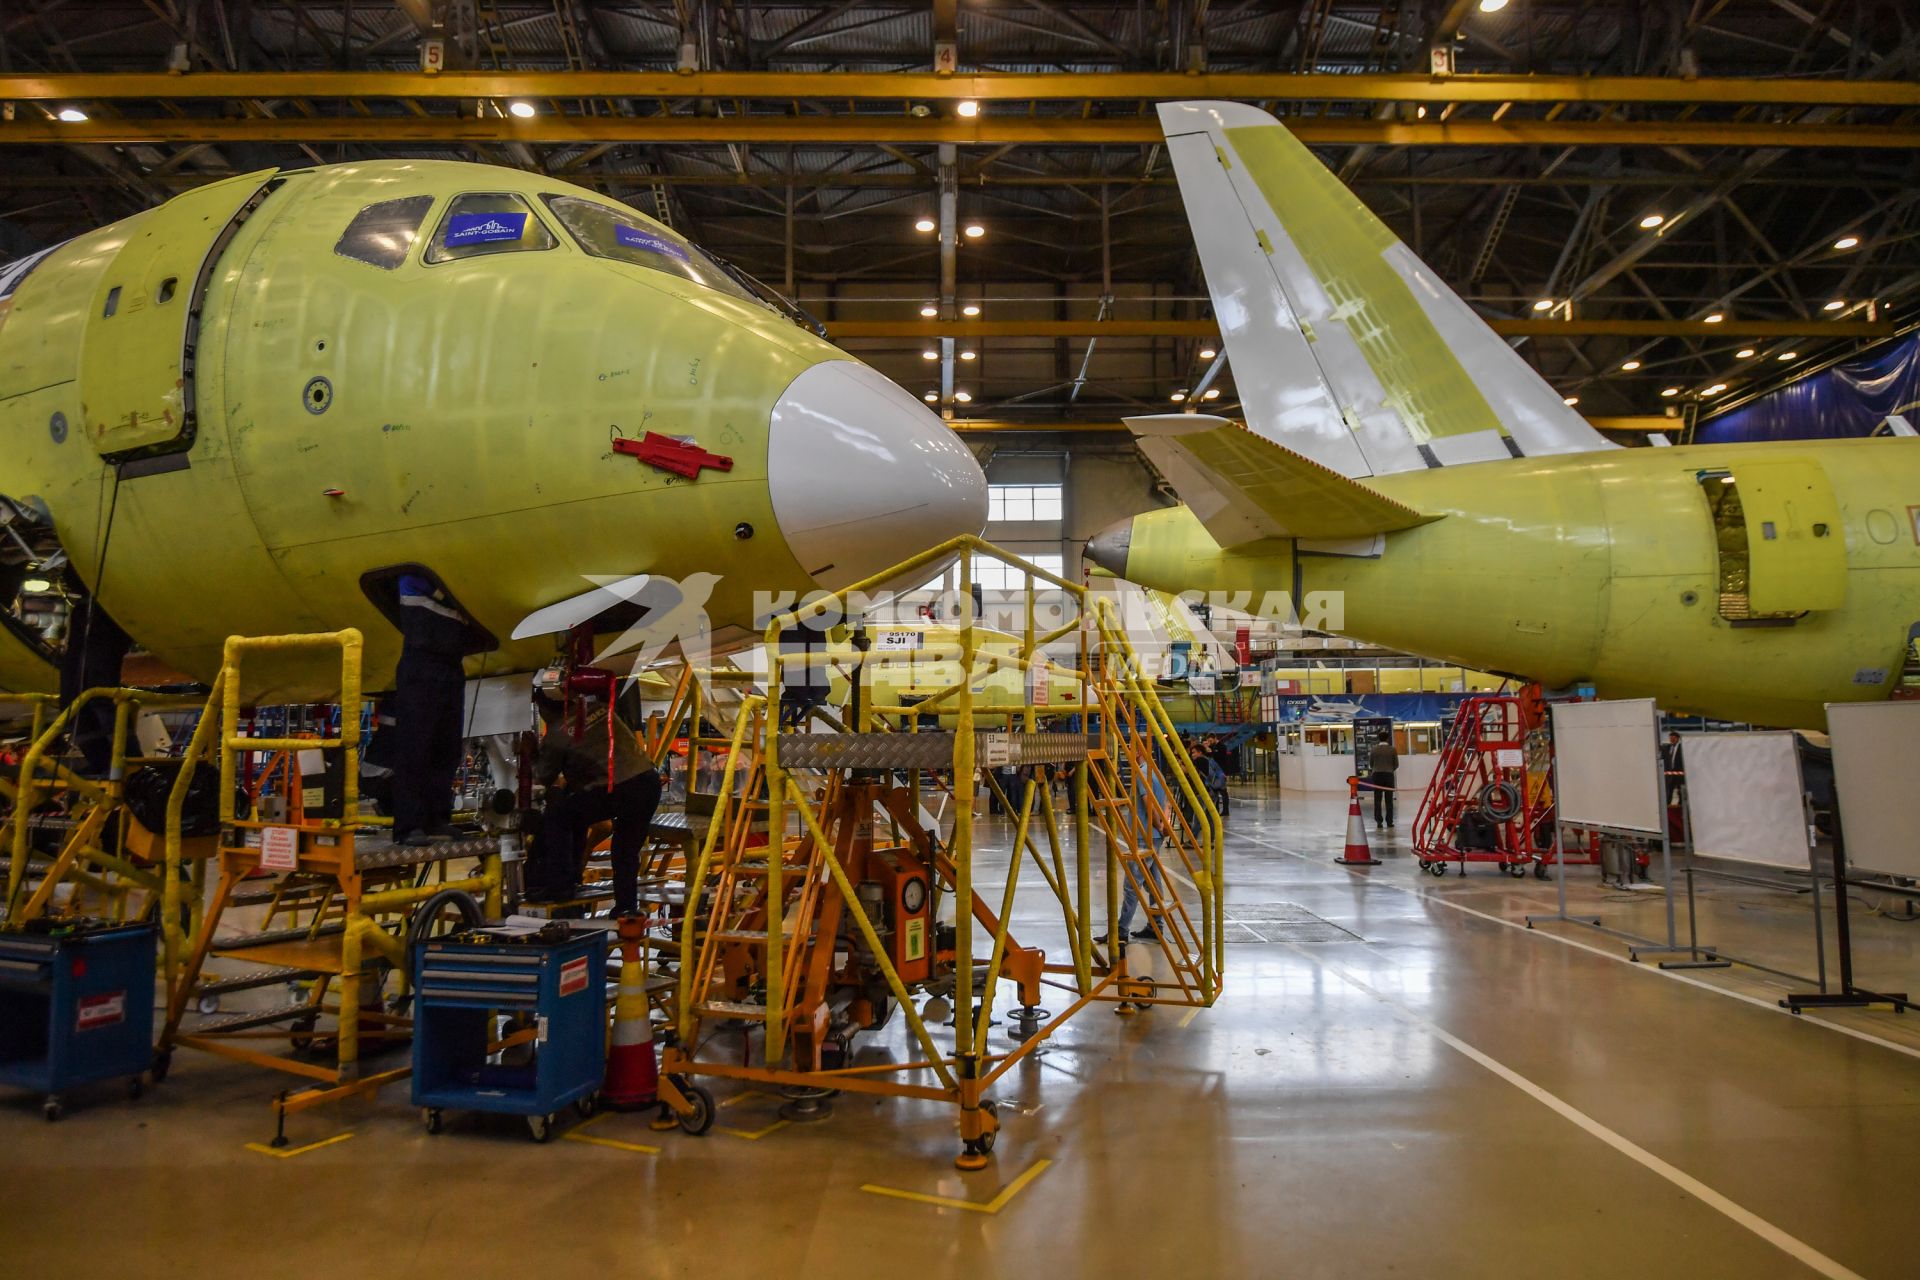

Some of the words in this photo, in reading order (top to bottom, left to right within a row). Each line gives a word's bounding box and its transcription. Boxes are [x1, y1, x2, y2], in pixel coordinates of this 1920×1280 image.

[429, 46, 439, 64] 5
[941, 47, 951, 63] 4
[1433, 50, 1444, 67] 3
[453, 228, 516, 238] SAINT-GOBAIN
